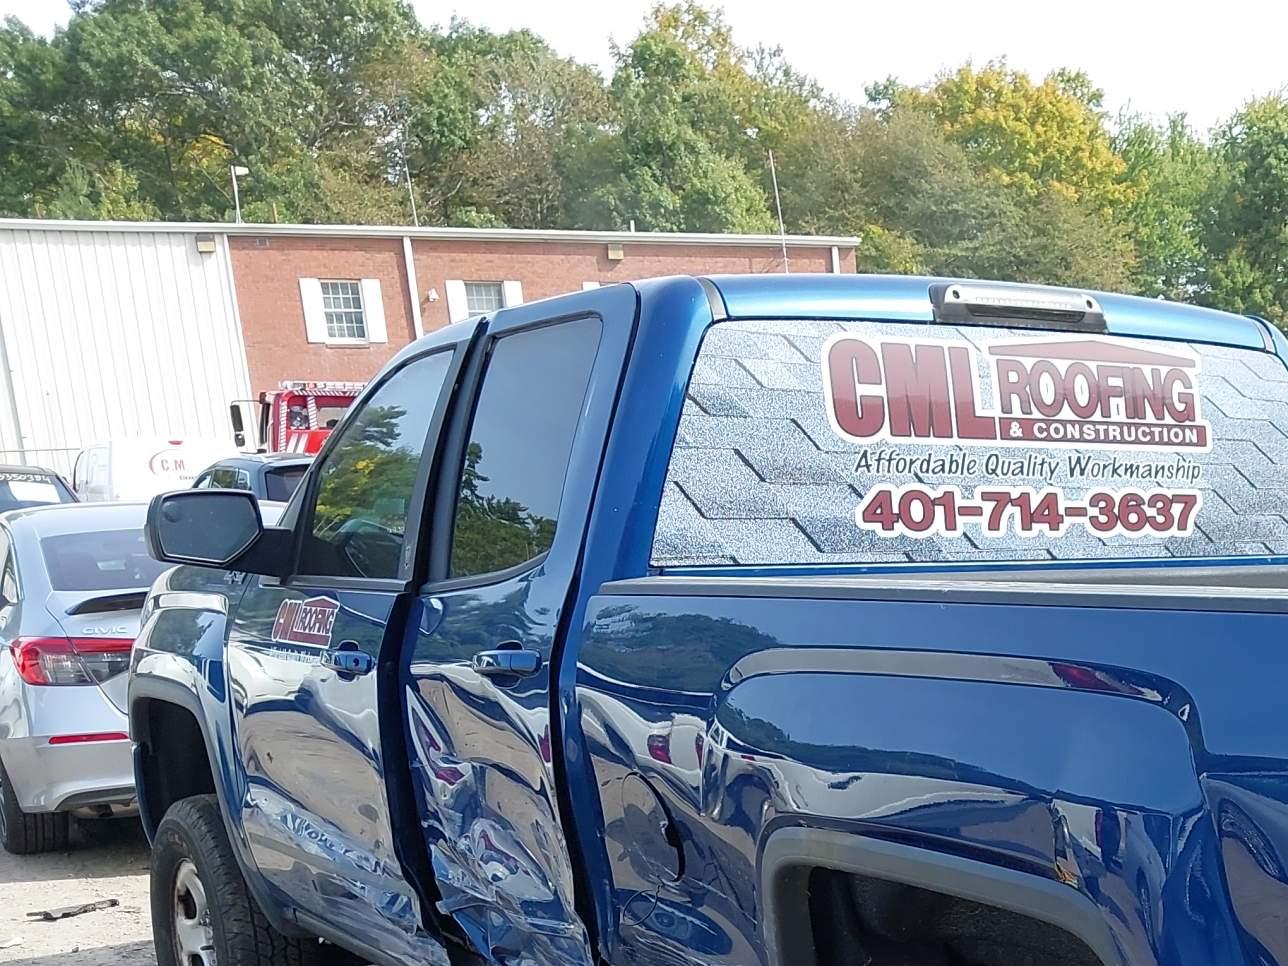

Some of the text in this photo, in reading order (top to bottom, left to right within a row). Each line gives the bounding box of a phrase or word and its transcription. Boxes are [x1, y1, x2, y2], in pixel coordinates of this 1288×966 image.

[828, 339, 1196, 440] CML ROOFING
[1009, 422, 1198, 444] & CONSTRUCTION
[854, 450, 1201, 485] Affordable Quality Workmanship
[862, 489, 1198, 532] 401-714-3637
[82, 626, 129, 635] CIVIC
